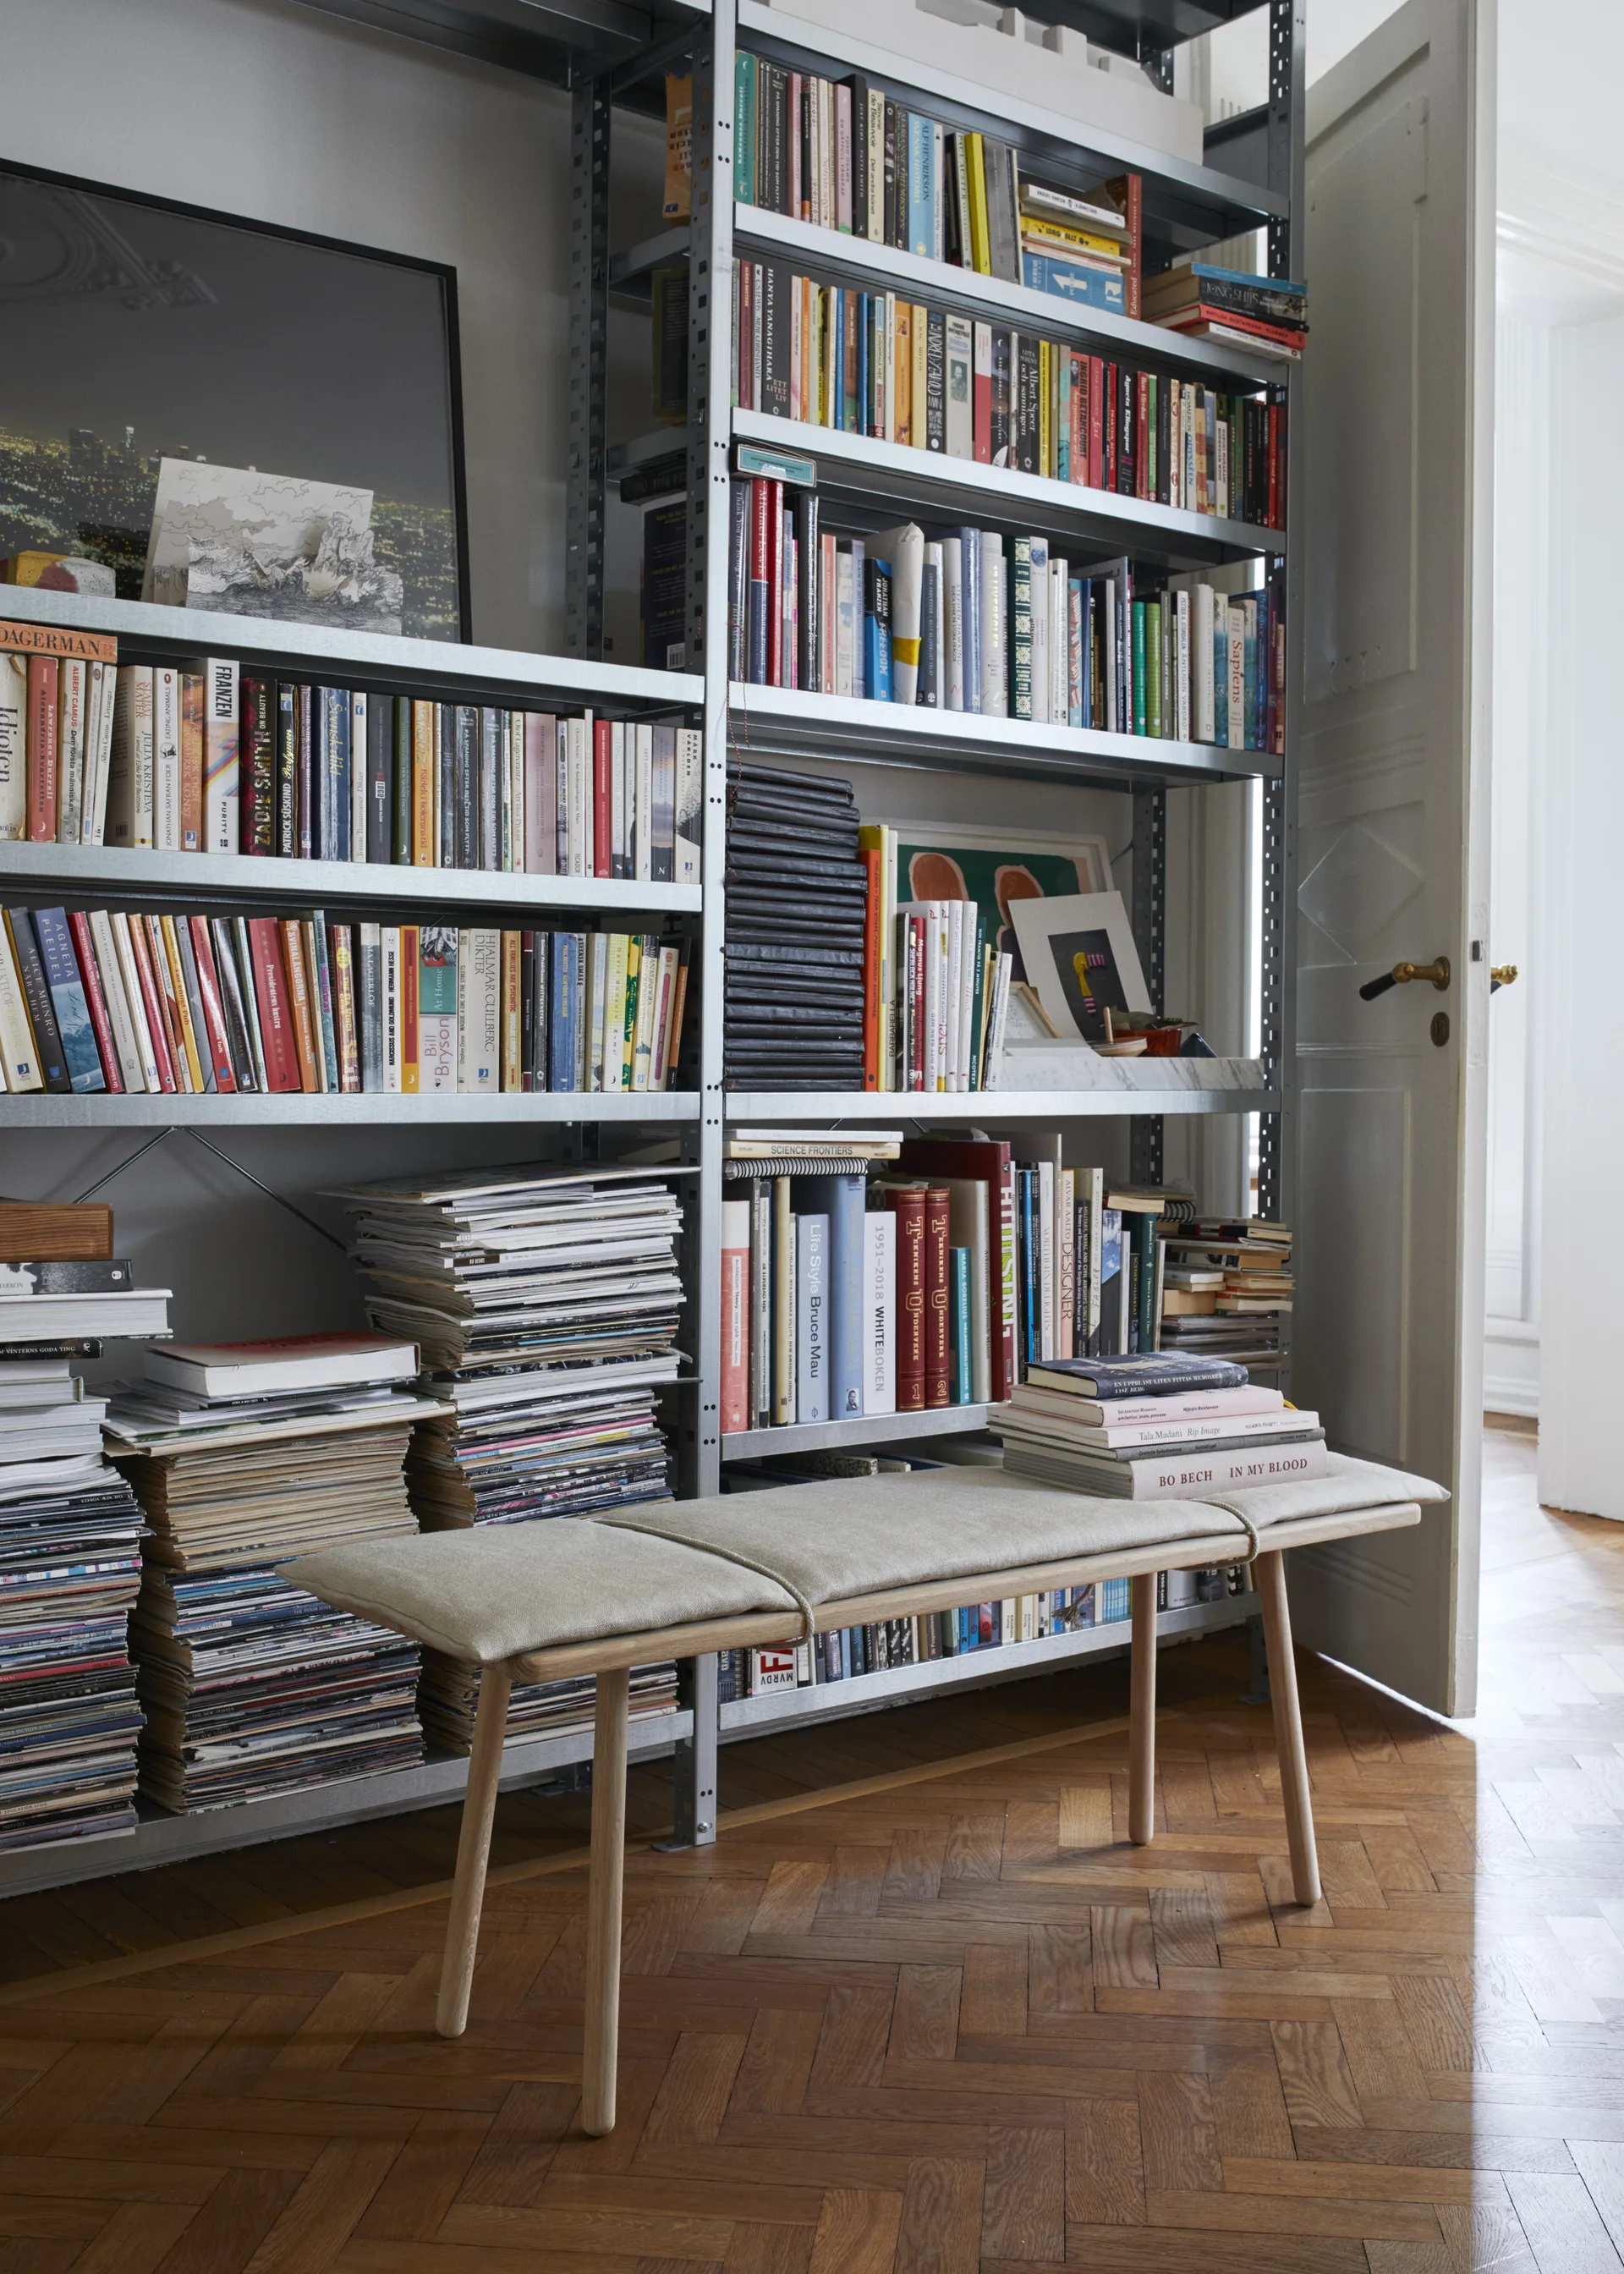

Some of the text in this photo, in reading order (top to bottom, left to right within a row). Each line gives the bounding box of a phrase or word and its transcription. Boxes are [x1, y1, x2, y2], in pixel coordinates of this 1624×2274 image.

[870, 94, 876, 106] de
[1027, 366, 1039, 432] Albert Speer
[1079, 360, 1088, 459] INGRID BETANCOURT
[757, 488, 766, 536] Michael
[757, 540, 765, 574] Lewis
[215, 666, 233, 717] FRANZEN
[1230, 640, 1243, 703] Sapiens
[143, 682, 151, 720] STABAT
[260, 718, 266, 729] ON
[69, 747, 77, 770] första
[254, 731, 272, 789] SMITH
[328, 697, 343, 776] Svensk dikt
[513, 739, 522, 782] Lagercrantz
[142, 732, 151, 814] JULIA KRISTEVA
[376, 781, 385, 799] LOGO
[254, 794, 272, 846] ZADIE
[282, 783, 292, 818] SÜSKIND
[283, 820, 292, 853] PATRICK
[41, 918, 62, 980] PLEIJEL
[54, 923, 74, 978] AGNETA
[287, 931, 305, 1002] SVINALÄNGORNA
[475, 935, 485, 975] DIKTER
[22, 966, 41, 1022] NÄRA HEM
[27, 947, 55, 1037] ALICE MUNRO
[266, 964, 281, 1029] Presidentens hustru
[434, 998, 442, 1012] At
[485, 935, 496, 1052] HJALMAR GULLBERG
[425, 1035, 436, 1057] Bill
[435, 1018, 453, 1076] Bryson
[771, 1145, 853, 1156] SCIENCE FRONTIERS
[807, 1223, 821, 1379] Life Style Bruce Mau
[1061, 1242, 1073, 1321] DESIGNER
[937, 1380, 947, 1397] 2
[1139, 1426, 1221, 1441] Tala Madani Rip Image
[1159, 1458, 1308, 1487] BO BECH IN MY BLOOD
[760, 1673, 793, 1685] MVRDV
